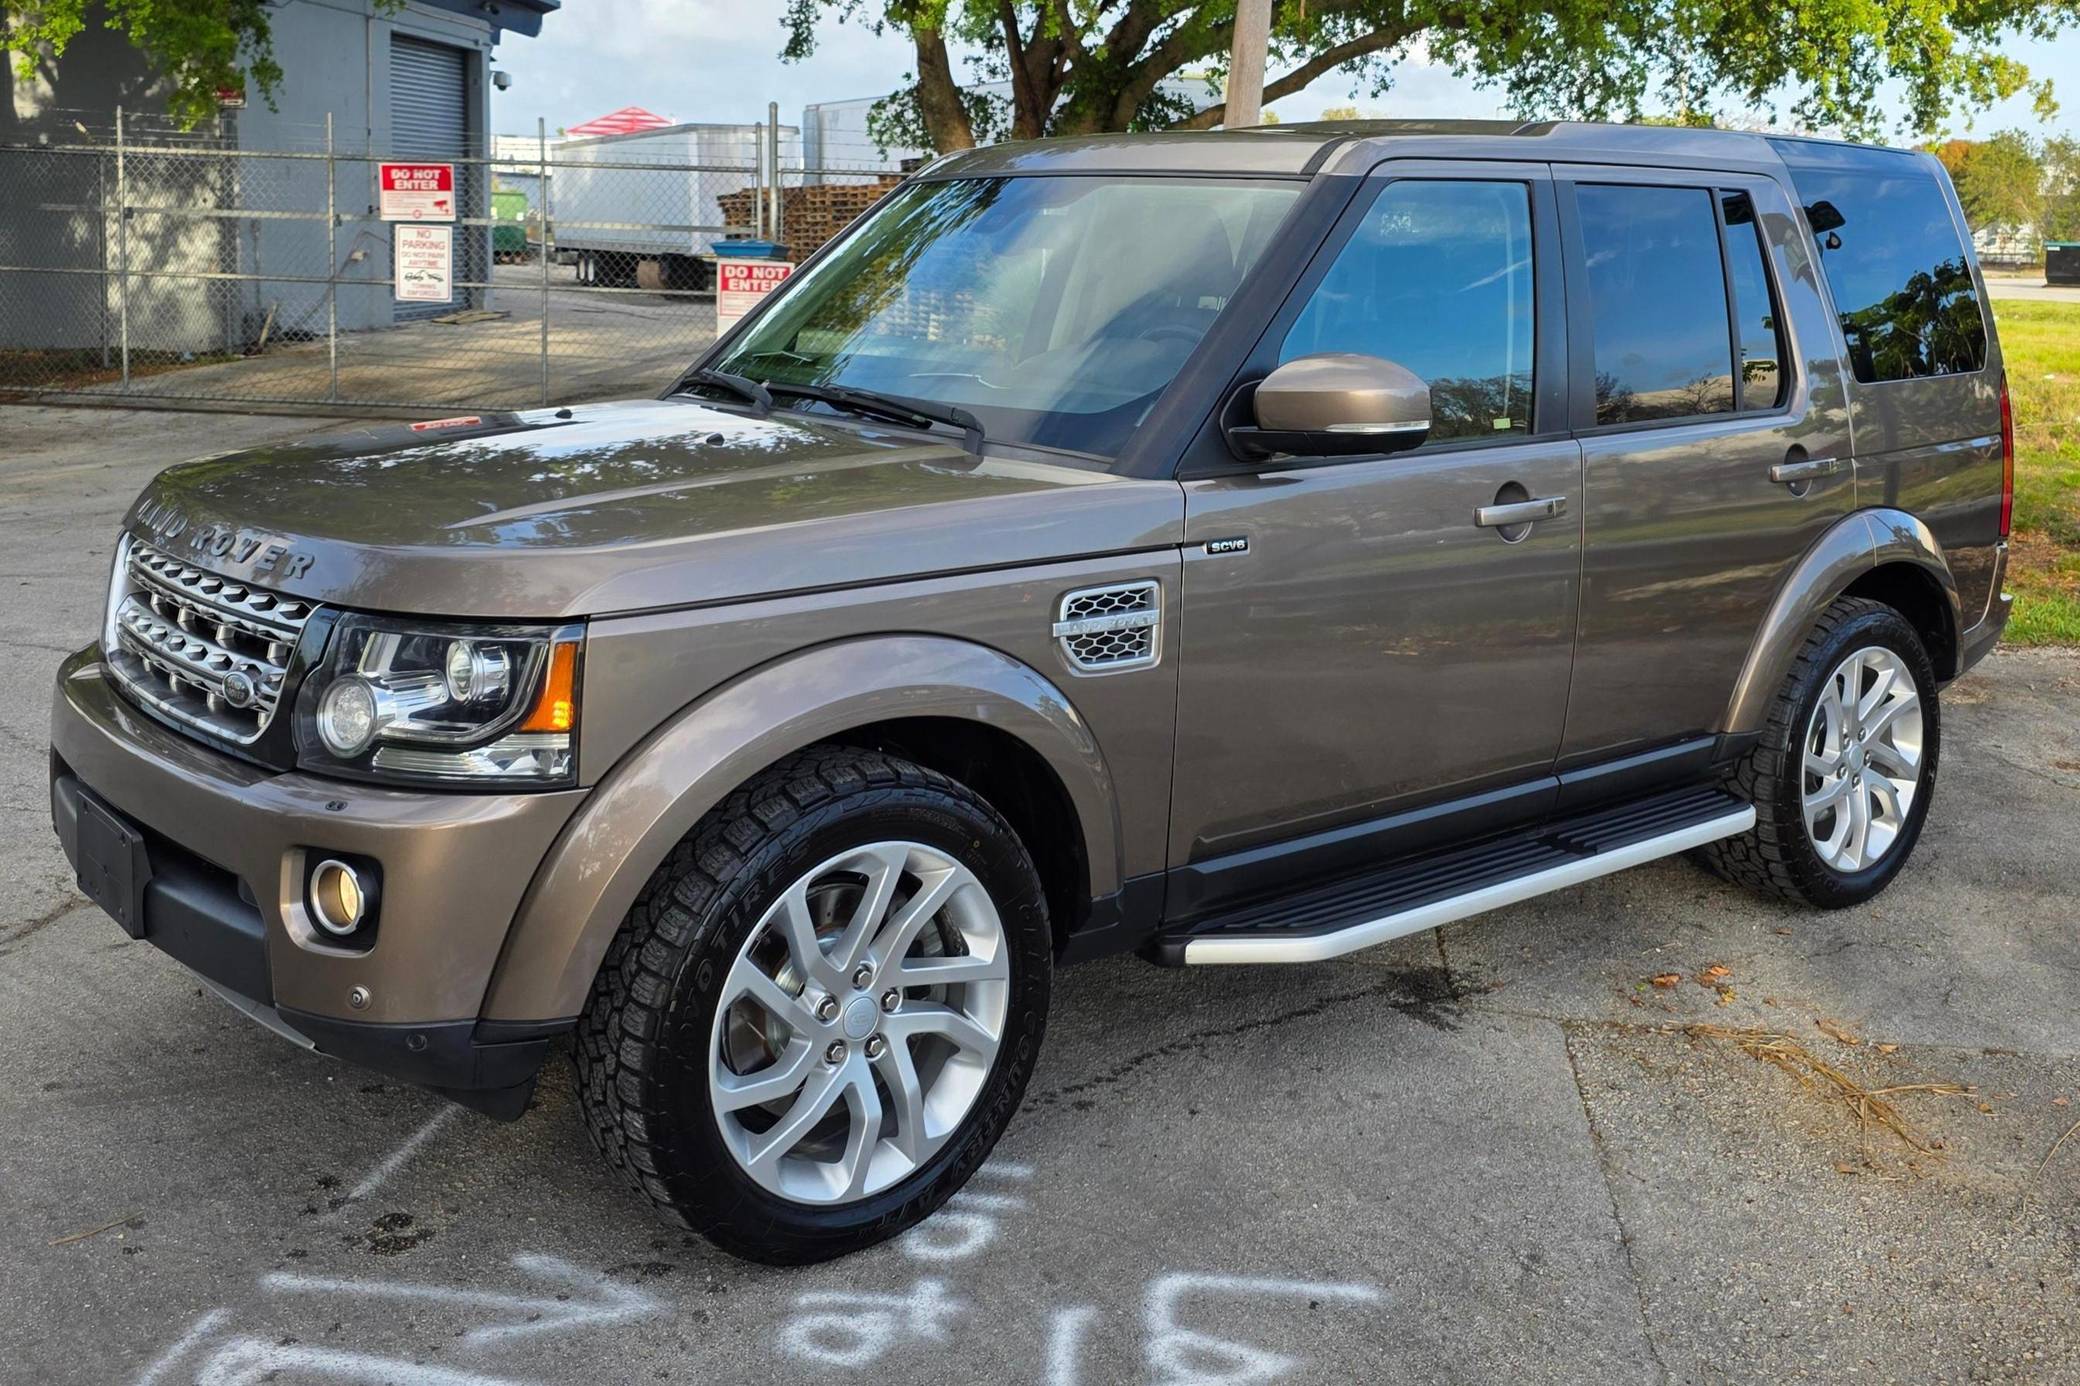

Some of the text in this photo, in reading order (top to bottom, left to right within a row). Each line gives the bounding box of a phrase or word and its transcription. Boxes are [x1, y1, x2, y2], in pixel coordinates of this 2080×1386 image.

[391, 169, 441, 180] DO NOT
[394, 180, 438, 190] ENTER
[416, 230, 432, 239] NO
[402, 239, 445, 250] PARKING
[408, 259, 438, 267] ANYTIME
[724, 266, 786, 279] DO NOT
[190, 523, 316, 580] ROVER
[1211, 539, 1246, 553] SCV6
